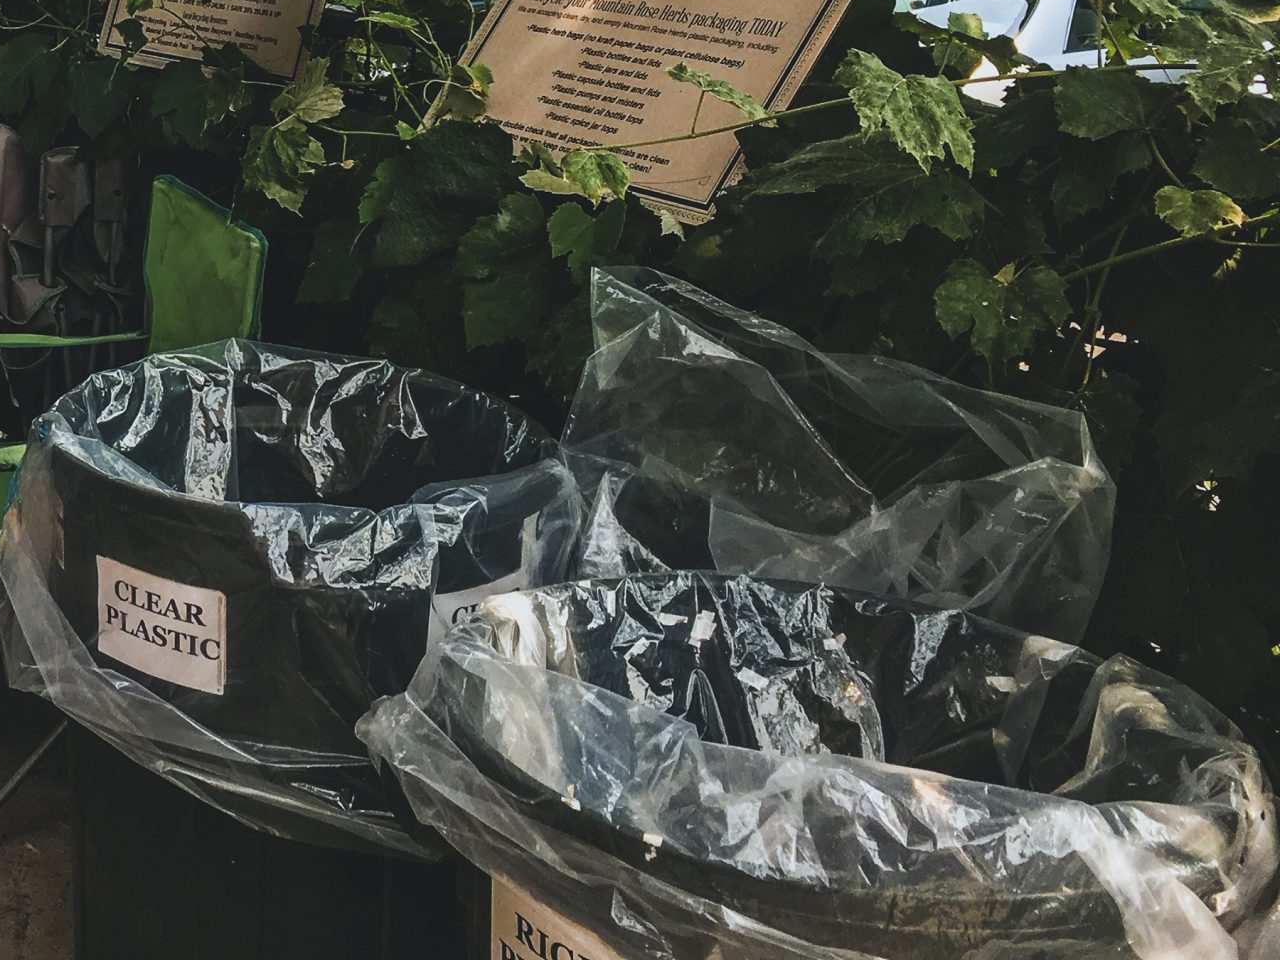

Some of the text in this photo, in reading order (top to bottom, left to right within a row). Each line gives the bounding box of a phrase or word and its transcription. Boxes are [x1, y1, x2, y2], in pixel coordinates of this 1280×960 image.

[536, 8, 562, 20] accepting
[590, 16, 604, 25] and
[604, 19, 622, 29] empty
[622, 21, 650, 32] Mountain
[650, 26, 668, 34] Rose
[668, 29, 688, 38] Herbs
[687, 32, 710, 42] plastic
[634, 1, 660, 18] Rose
[658, 4, 691, 24] Herbs
[688, 12, 749, 36] packaging
[748, 18, 788, 38] TODAY
[550, 27, 566, 37] herb
[566, 30, 583, 41] bags
[582, 34, 596, 43] (no
[596, 35, 615, 45] kraft
[614, 39, 636, 50] paper
[635, 42, 654, 52] bags
[662, 46, 684, 58] plant
[684, 50, 720, 64] cellulose
[720, 56, 746, 70] bags)
[606, 51, 632, 63] bottles
[632, 55, 648, 66] and
[646, 58, 663, 69] lids
[602, 64, 618, 76] jars
[618, 68, 634, 78] and
[632, 70, 649, 80] lids
[577, 74, 606, 88] capsule
[605, 80, 630, 92] bottles
[630, 84, 646, 94] and
[646, 86, 662, 98] lids
[576, 89, 602, 102] pumps
[602, 93, 616, 104] and
[616, 96, 646, 110] misters
[562, 100, 595, 114] essential
[594, 106, 606, 116] oil
[605, 108, 628, 121] bottle
[627, 114, 644, 126] tops
[570, 118, 590, 128] spice
[588, 122, 602, 132] jar
[601, 124, 620, 136] tops
[502, 120, 524, 130] double
[524, 126, 544, 136] check
[544, 130, 560, 140] that
[608, 146, 636, 157] aterials
[636, 152, 649, 161] are
[648, 154, 670, 166] clean
[543, 140, 558, 152] keep
[628, 161, 652, 174] clean!
[114, 578, 208, 628] CLEAR
[105, 604, 222, 662] PLASTIC
